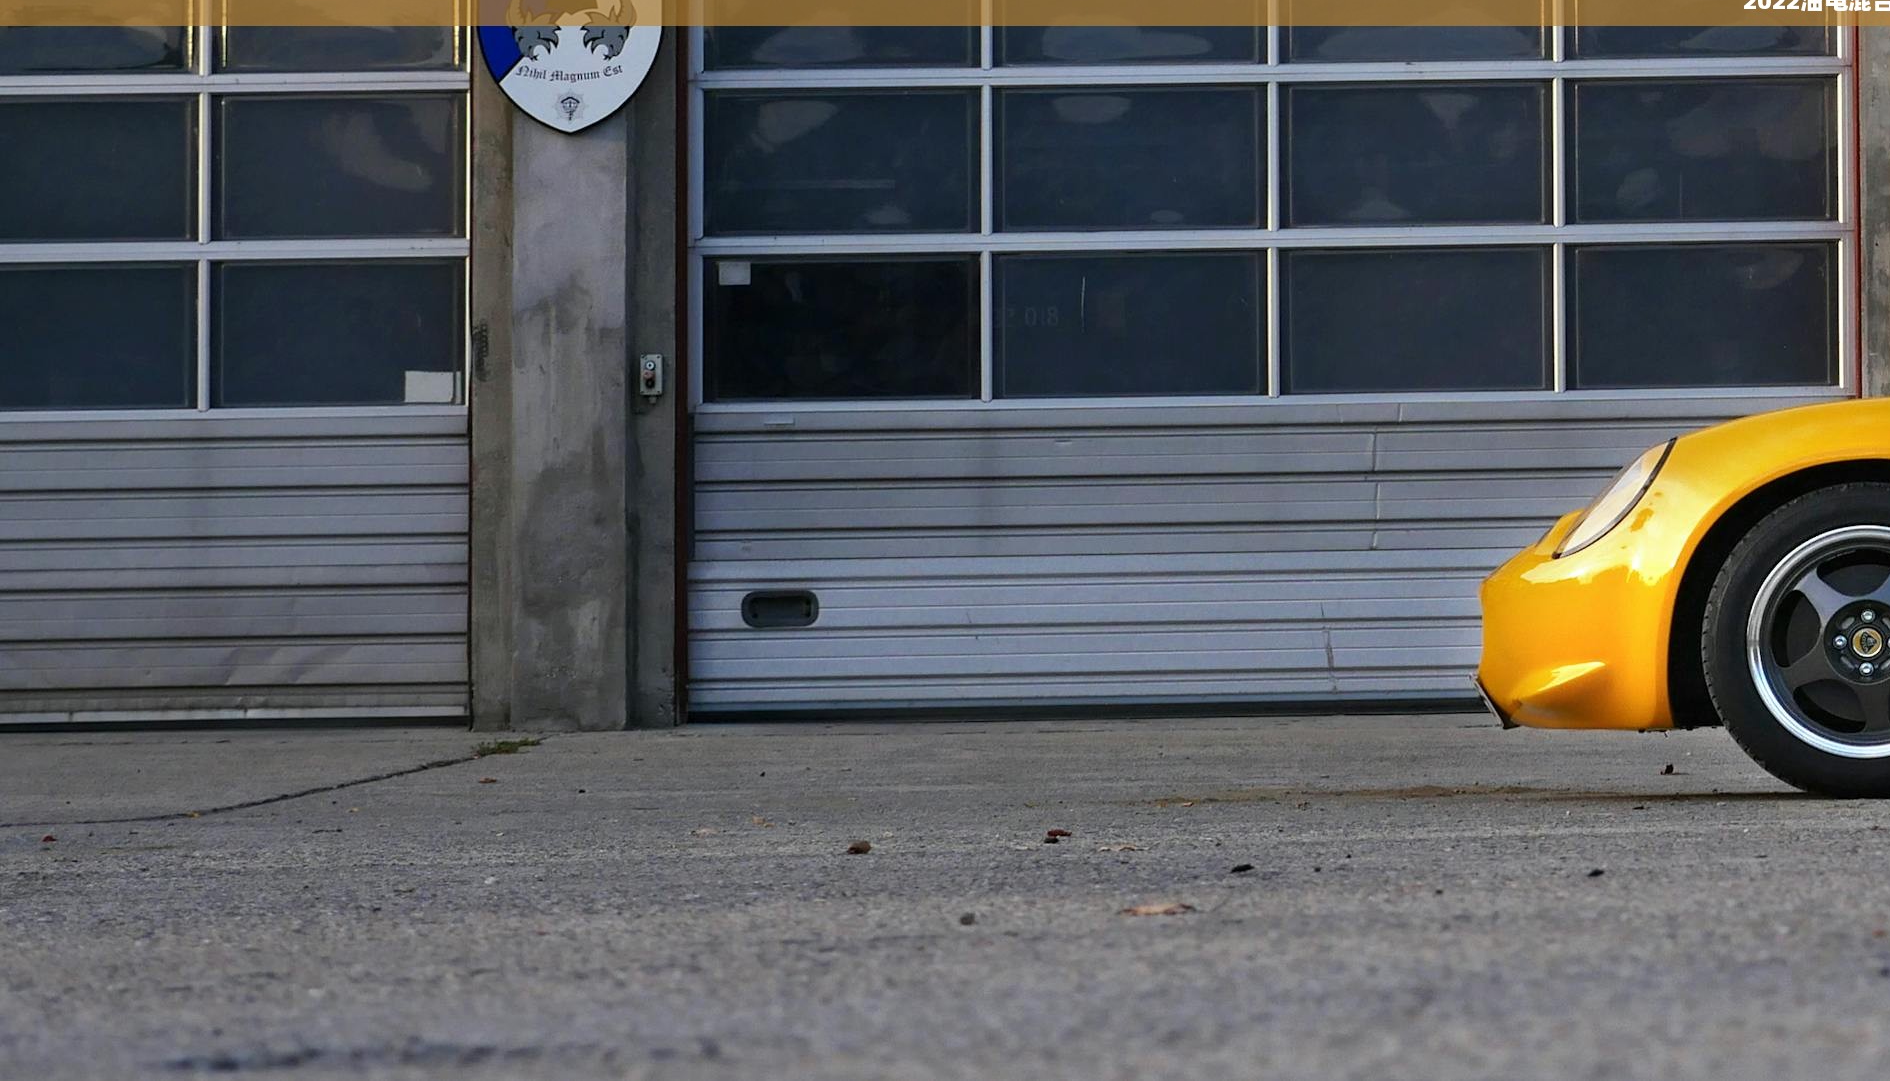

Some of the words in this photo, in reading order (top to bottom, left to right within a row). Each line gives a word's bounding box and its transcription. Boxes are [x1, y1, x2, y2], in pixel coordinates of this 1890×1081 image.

[515, 65, 547, 80] Nihil
[549, 70, 600, 83] Magnum
[603, 65, 623, 77] Est
